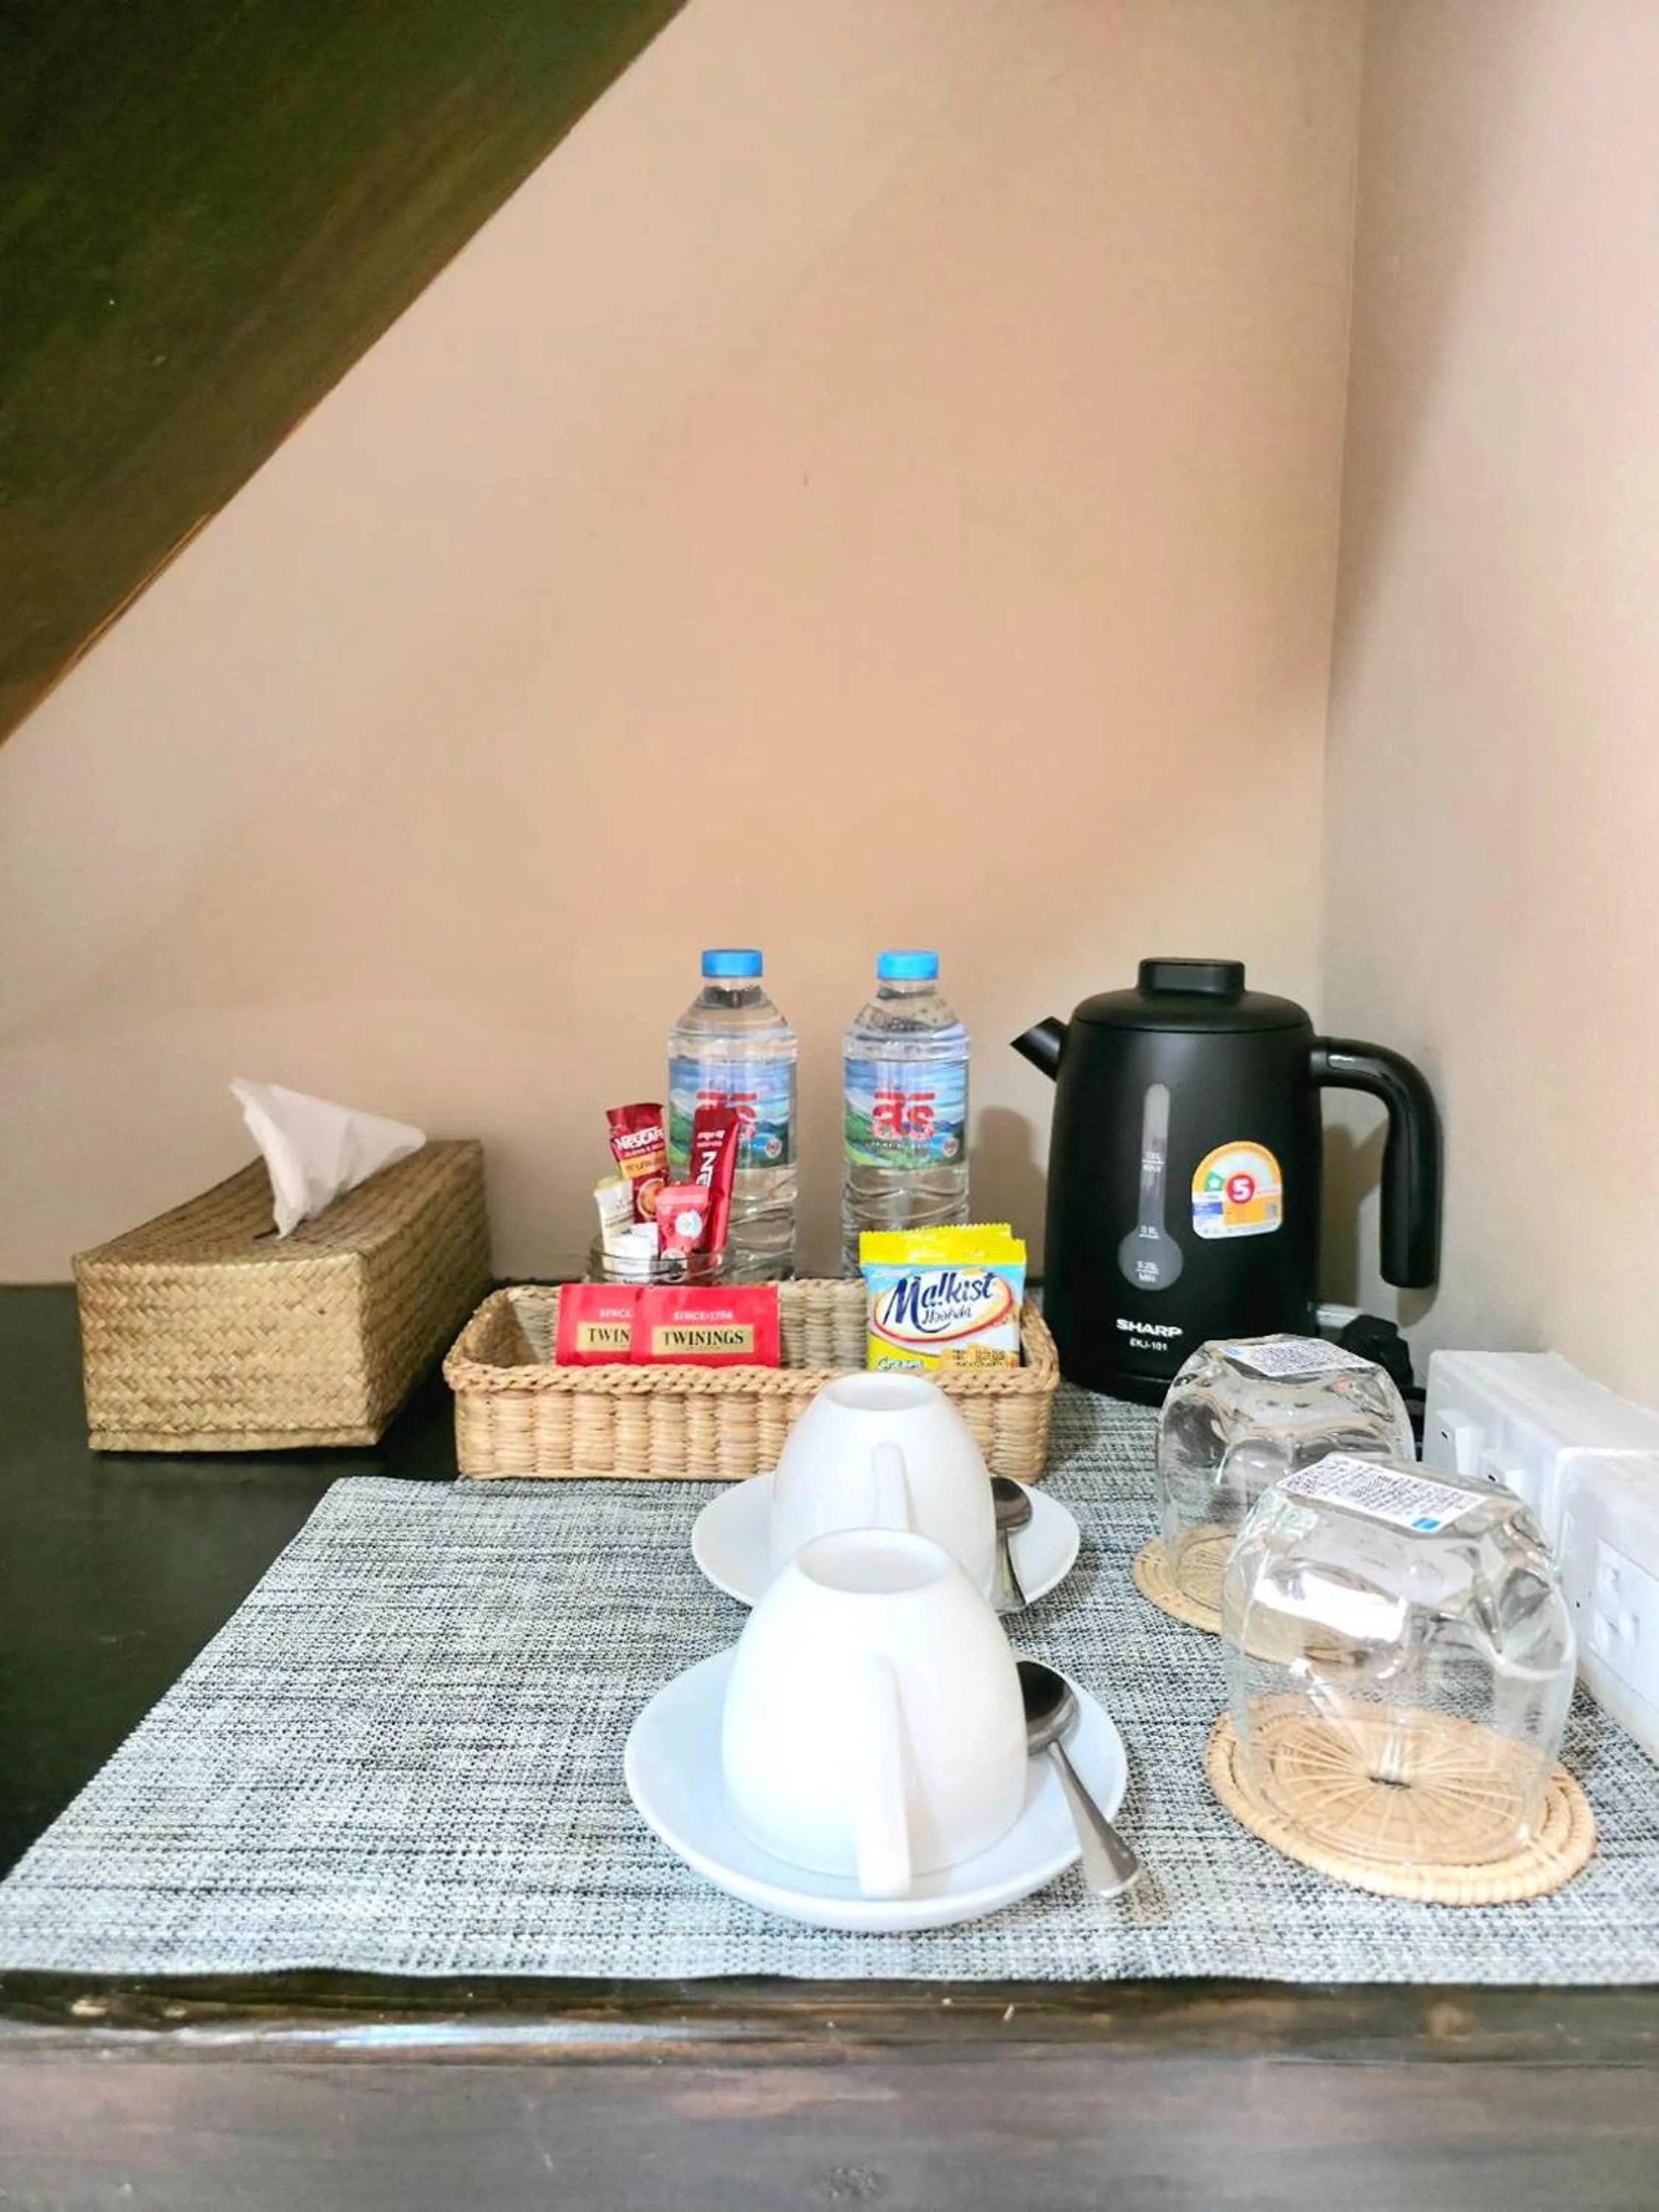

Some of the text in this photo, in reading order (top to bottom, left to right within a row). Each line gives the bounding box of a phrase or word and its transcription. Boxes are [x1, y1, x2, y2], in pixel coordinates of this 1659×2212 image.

[1232, 1178, 1253, 1200] 5
[882, 1271, 998, 1333] Malkist
[589, 1328, 630, 1343] TWIN
[664, 1330, 744, 1346] TWININGS
[1116, 1318, 1183, 1338] SHARP
